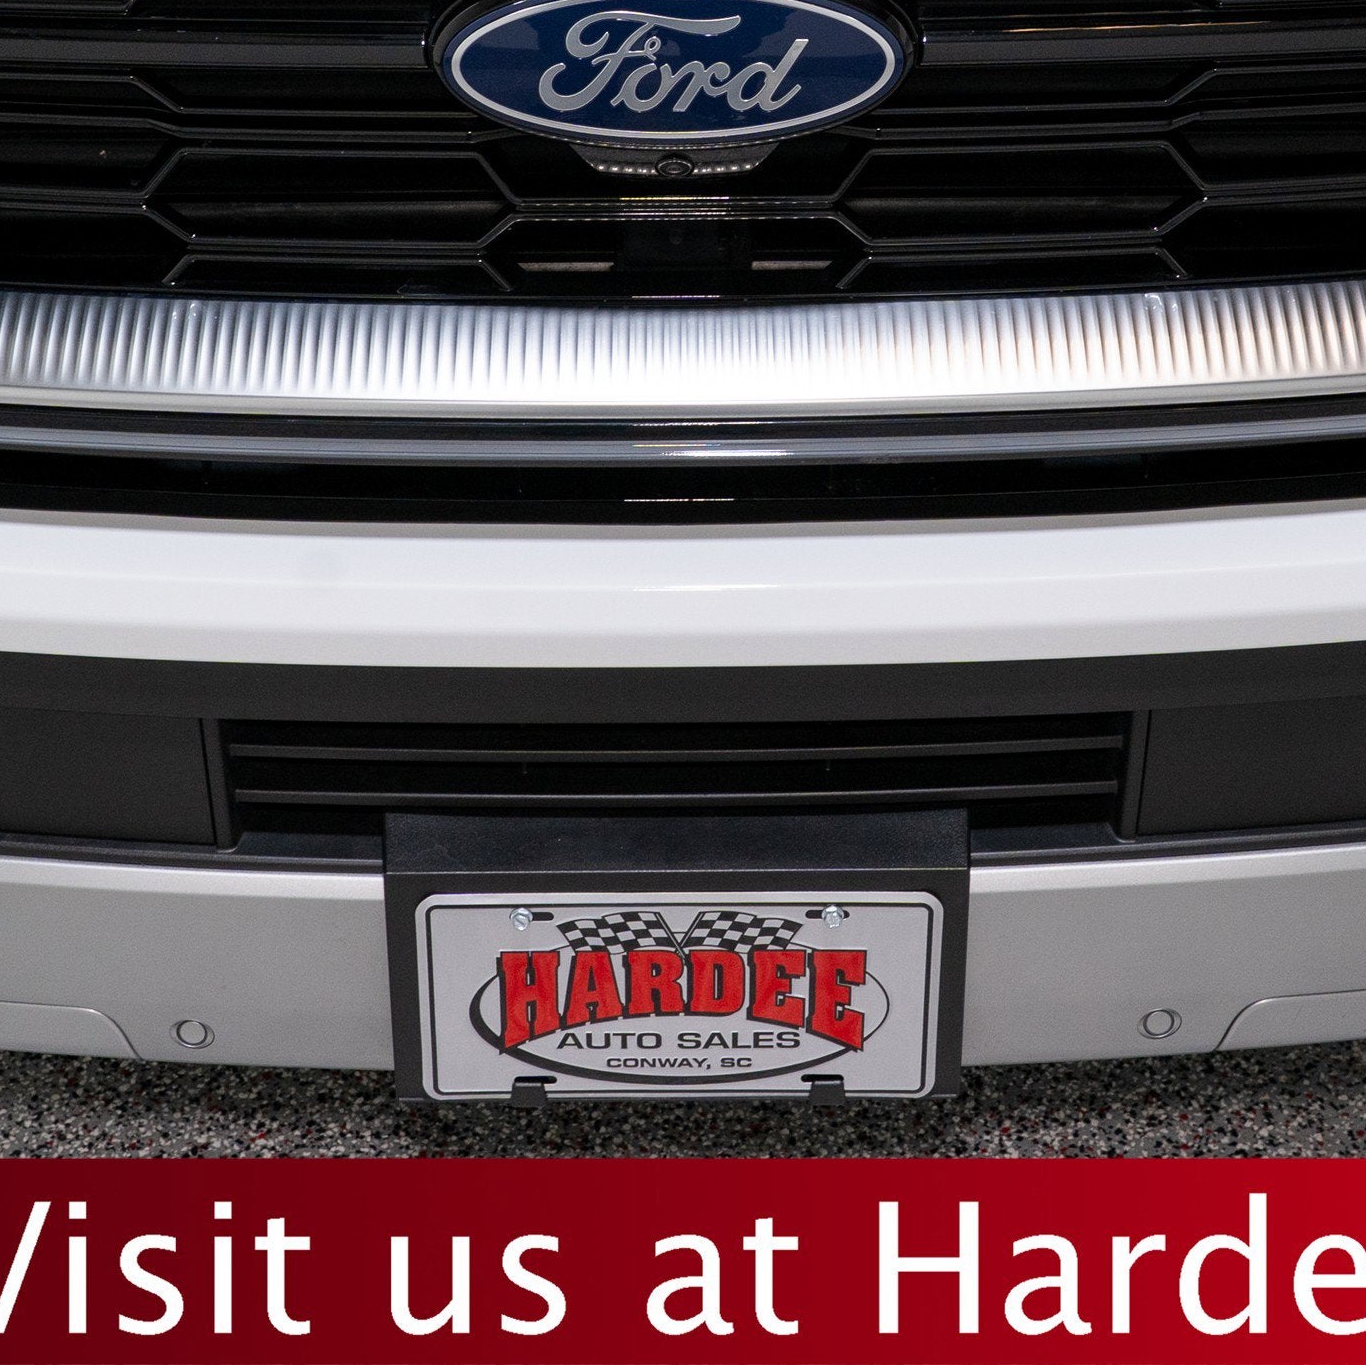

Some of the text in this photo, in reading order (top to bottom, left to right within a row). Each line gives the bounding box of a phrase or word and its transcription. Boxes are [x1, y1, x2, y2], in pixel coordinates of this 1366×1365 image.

[539, 10, 809, 112] Ford
[498, 950, 867, 1053] HARDEE
[557, 1031, 801, 1050] AUTO SALES
[606, 1057, 752, 1071] CONWAY, SC
